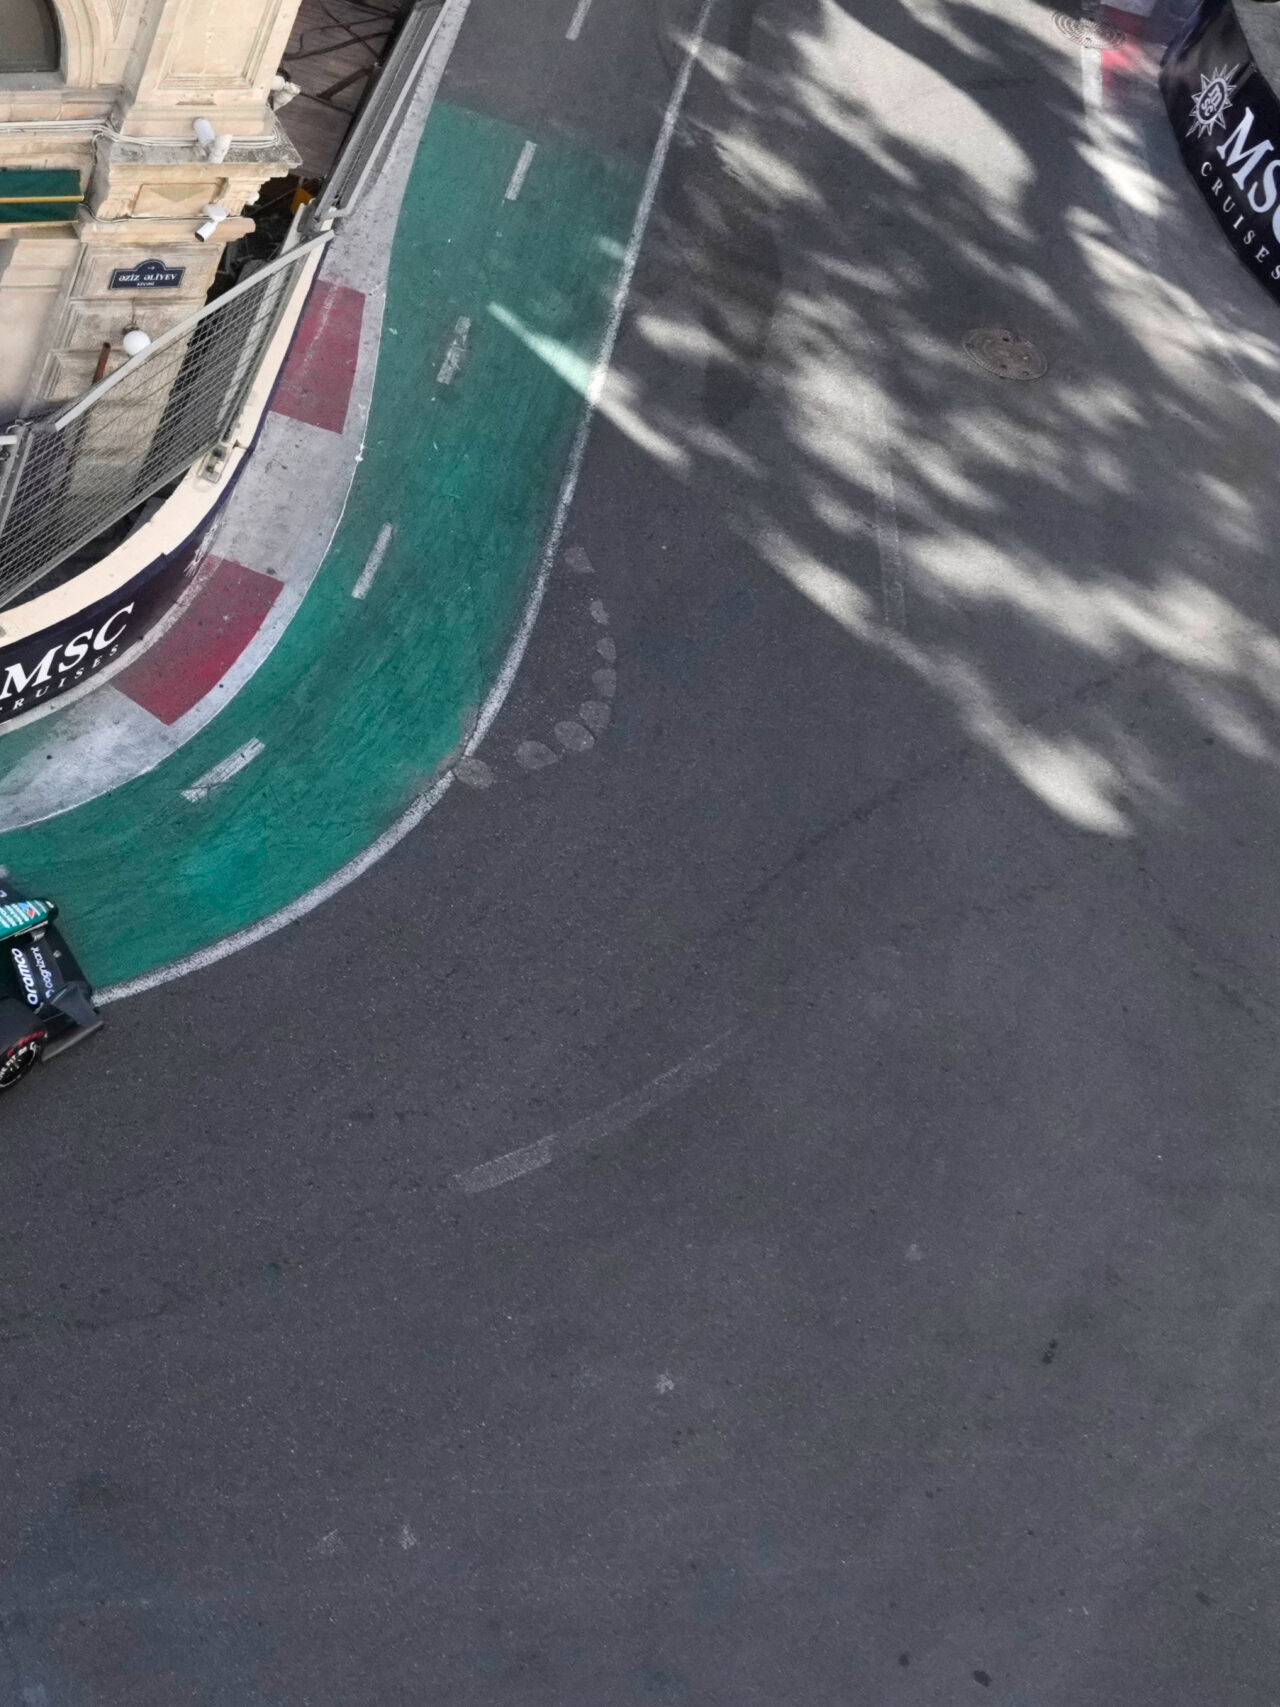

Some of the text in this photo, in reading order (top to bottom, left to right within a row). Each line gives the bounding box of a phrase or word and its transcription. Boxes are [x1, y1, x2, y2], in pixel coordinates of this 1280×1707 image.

[1216, 107, 1280, 243] MS
[143, 273, 177, 281] ƏLİYEV
[11, 948, 38, 1005] aramco
[30, 947, 54, 988] cognizant
